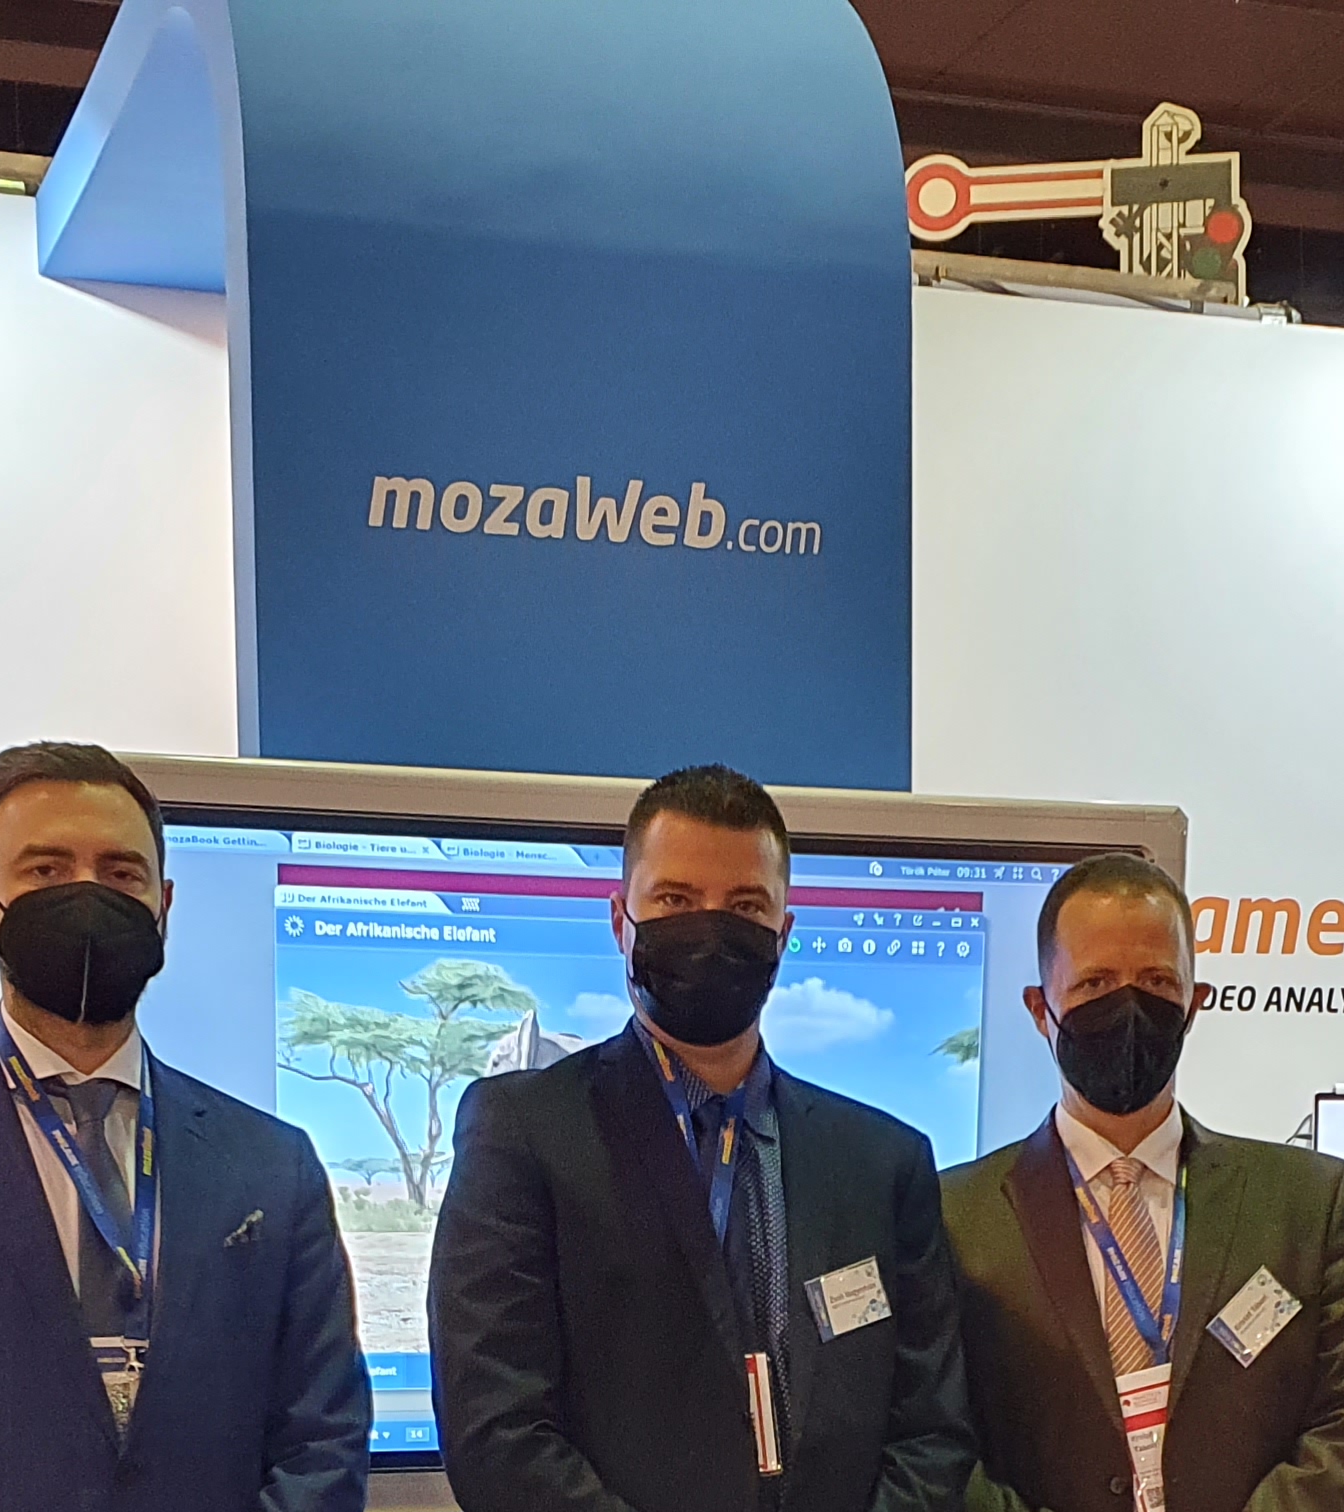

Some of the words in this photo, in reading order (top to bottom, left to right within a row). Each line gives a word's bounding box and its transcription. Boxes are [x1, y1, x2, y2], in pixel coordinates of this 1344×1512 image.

[368, 476, 822, 555] mozaWeb.com
[315, 841, 358, 852] Biologie
[463, 848, 505, 860] Biologie
[956, 867, 987, 879] 09:31
[298, 893, 317, 903] Der
[390, 897, 428, 908] Elefant
[315, 919, 343, 937] Der
[345, 921, 439, 942] Afrikanische
[443, 925, 496, 944] Elefant
